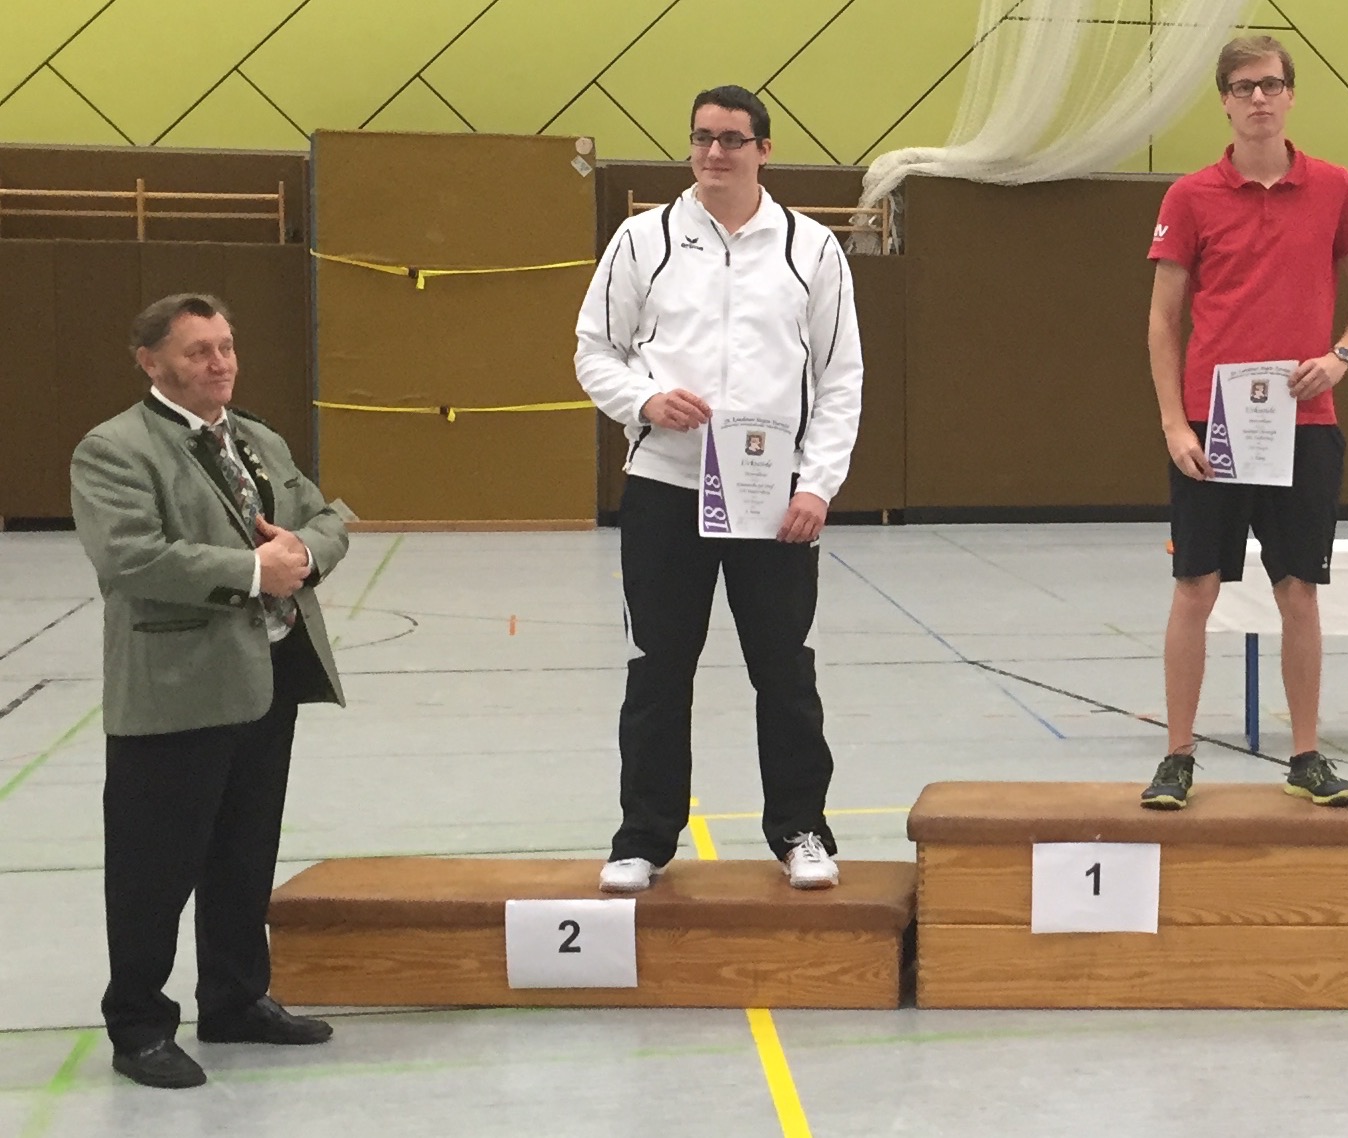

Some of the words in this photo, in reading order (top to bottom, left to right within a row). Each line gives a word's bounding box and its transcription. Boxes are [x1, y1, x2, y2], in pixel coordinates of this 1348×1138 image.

[1211, 423, 1229, 447] 18
[704, 473, 723, 500] 18
[703, 505, 729, 532] 18
[1085, 862, 1101, 896] 1
[558, 919, 582, 954] 2
